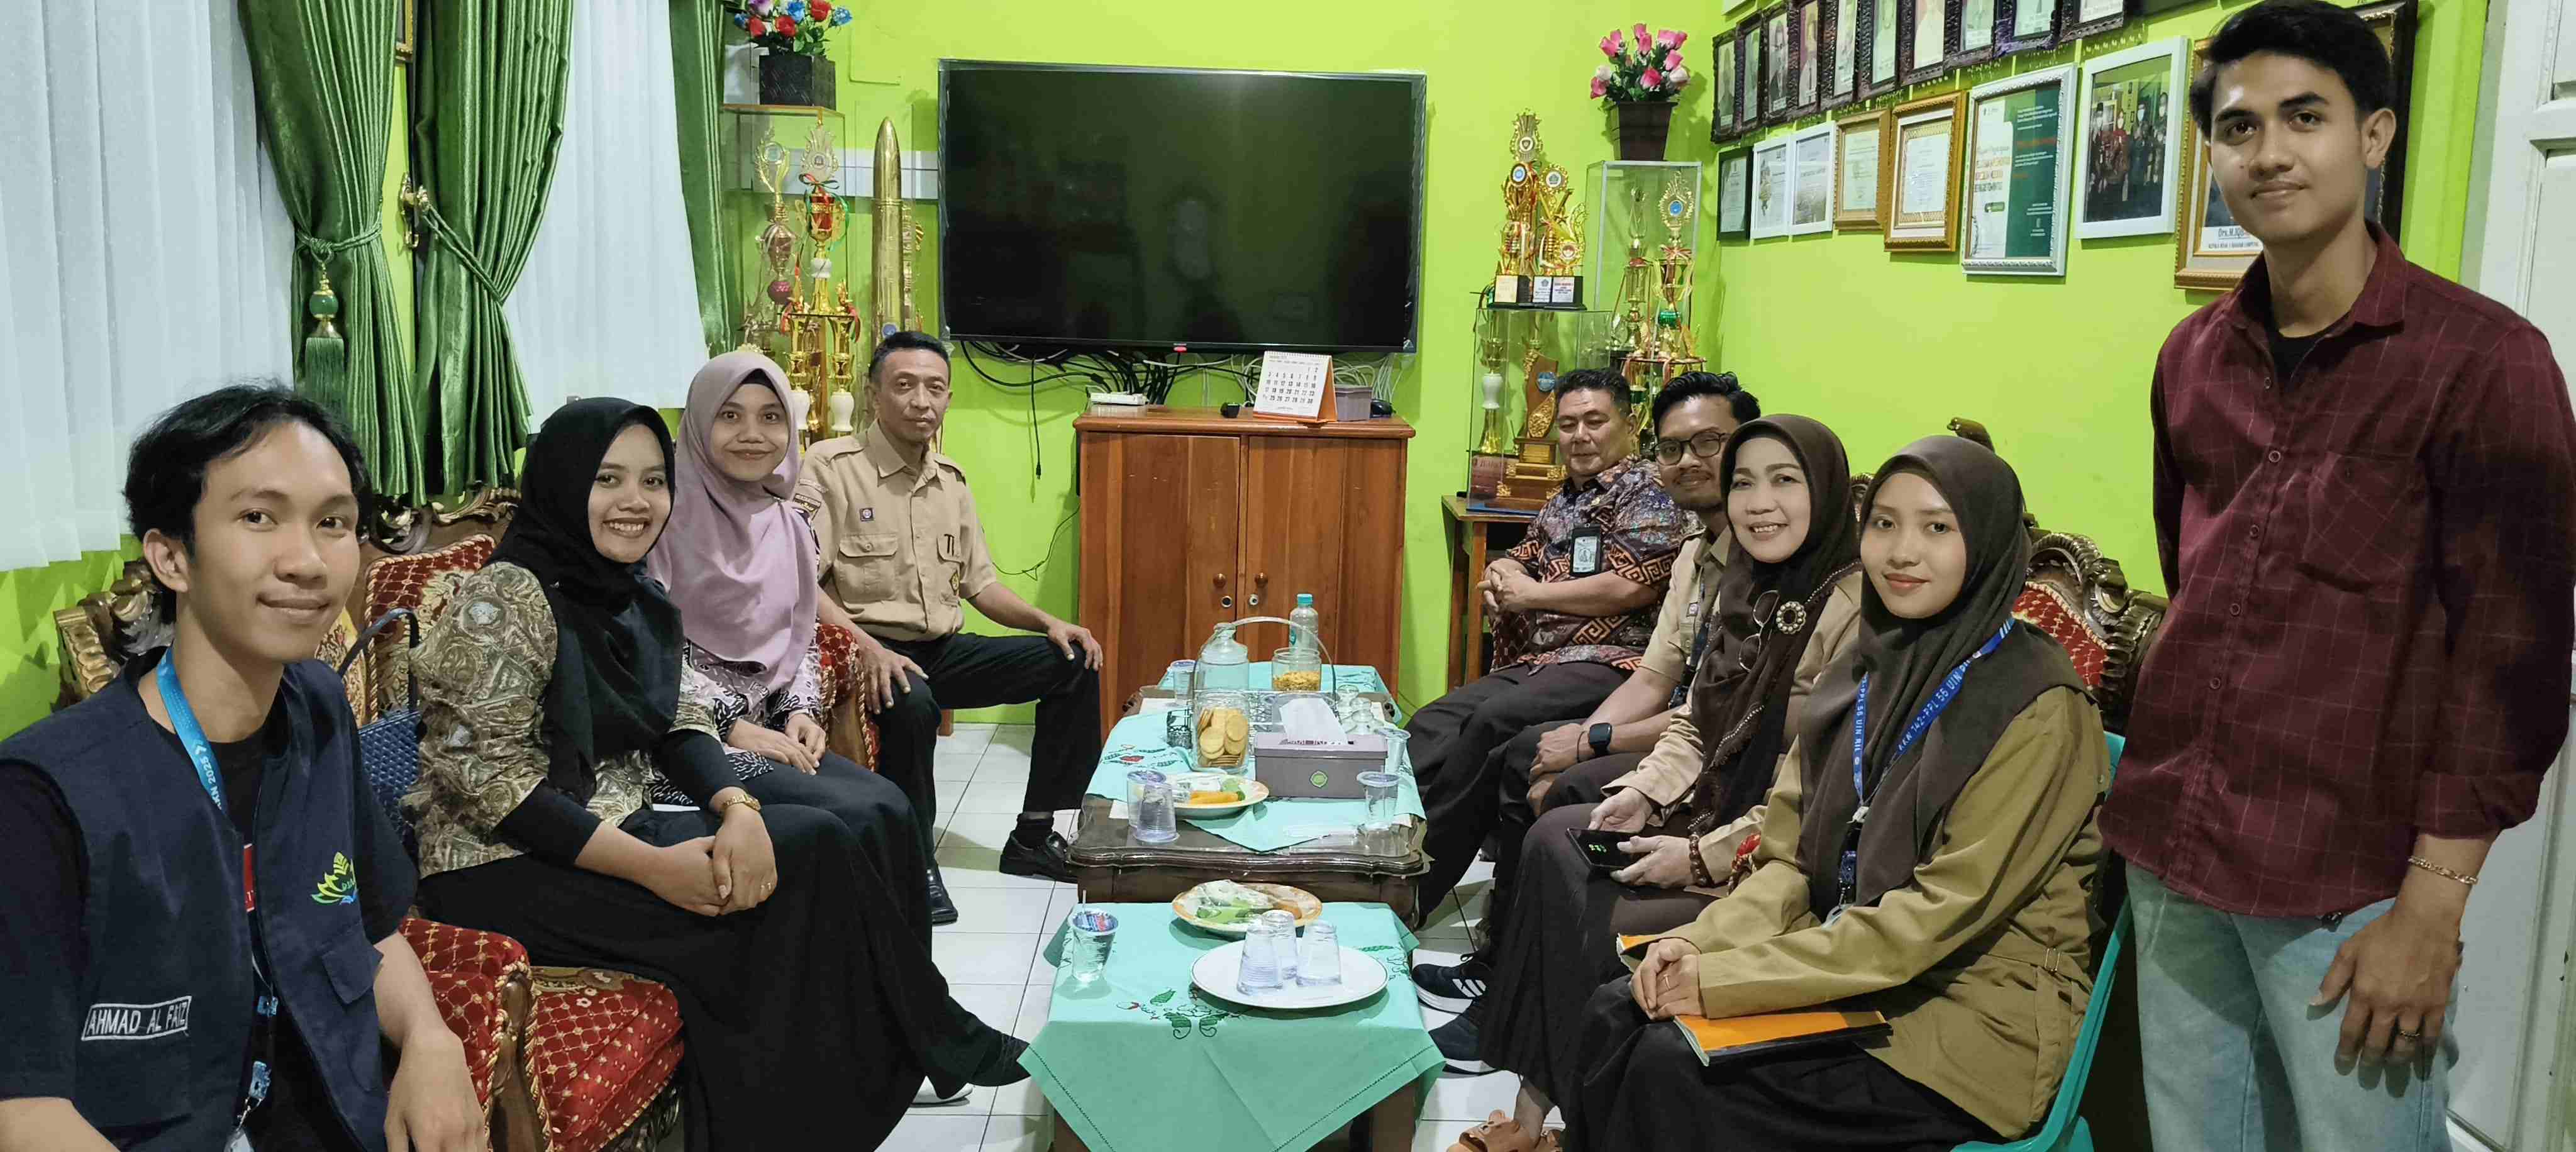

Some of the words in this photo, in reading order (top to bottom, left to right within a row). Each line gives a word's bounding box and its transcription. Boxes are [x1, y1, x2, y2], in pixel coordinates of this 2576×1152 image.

[1946, 670, 1963, 690] UIN
[200, 756, 216, 785] 2025
[86, 1009, 141, 1035] AHMAD
[146, 1009, 162, 1034] AL
[165, 1002, 187, 1029] FAIZ
